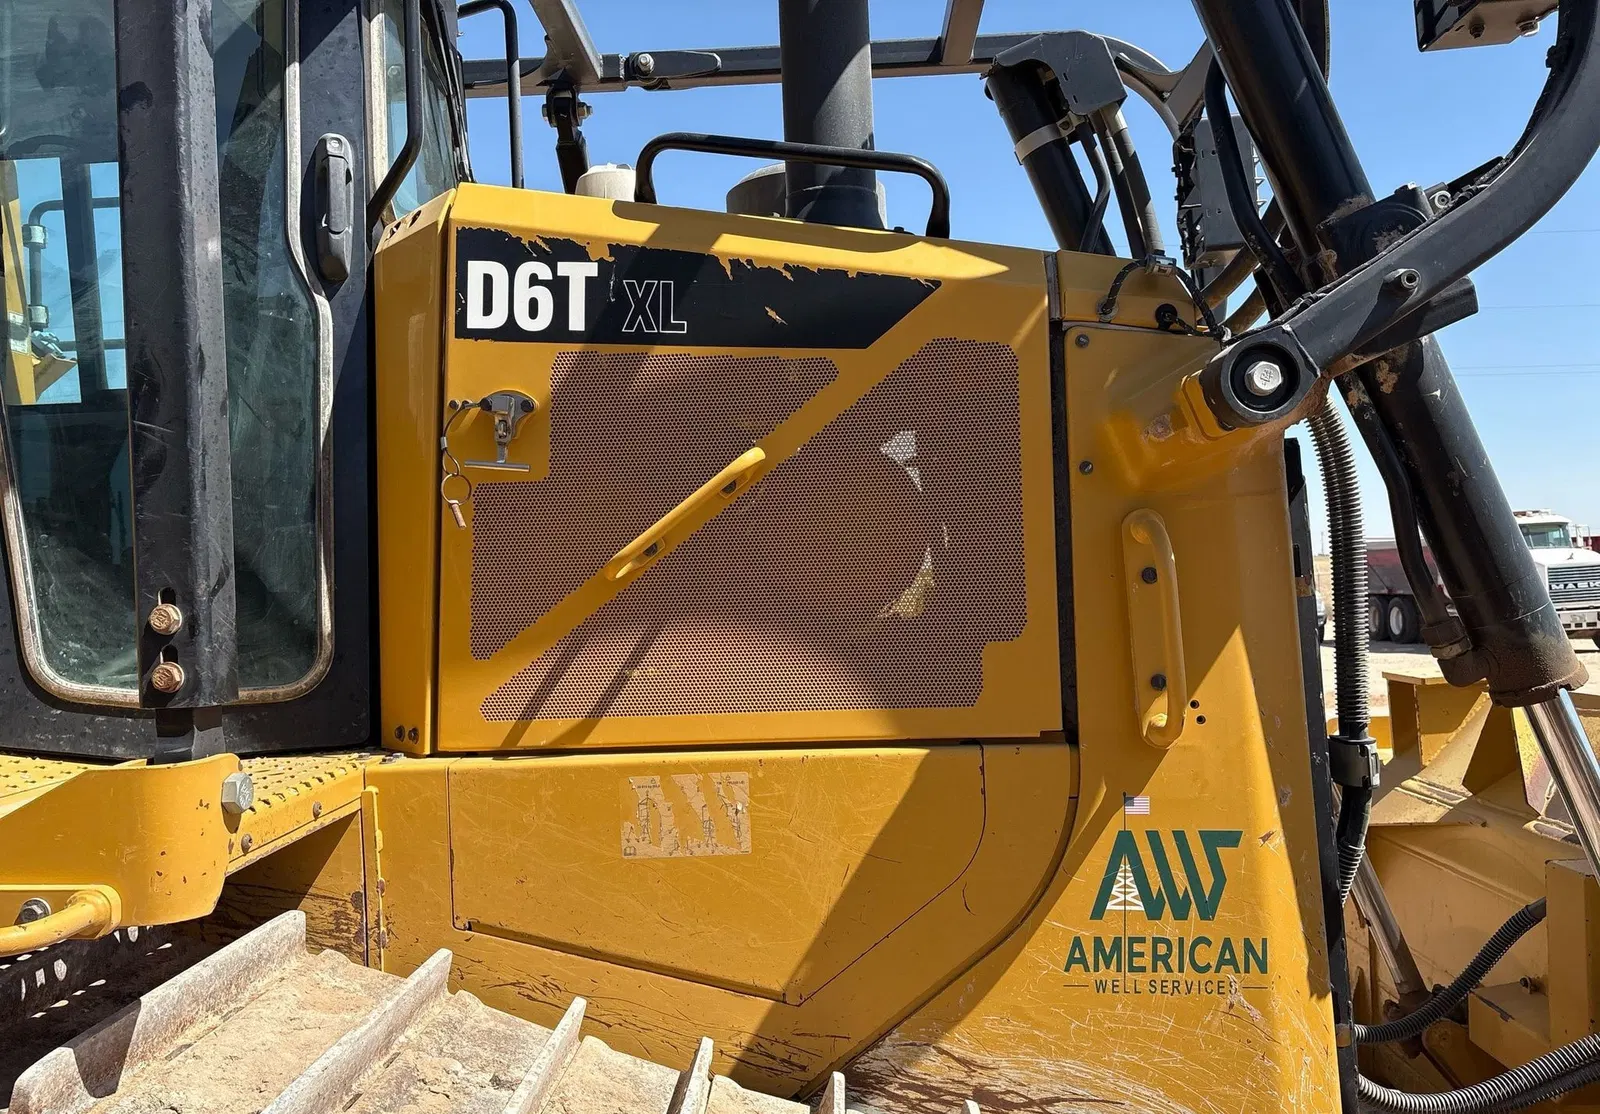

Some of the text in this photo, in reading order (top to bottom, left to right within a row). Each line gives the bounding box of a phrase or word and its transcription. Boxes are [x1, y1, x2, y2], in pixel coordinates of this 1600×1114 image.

[466, 260, 688, 334] D6T XL
[1063, 936, 1268, 974] AMERICAN
[1095, 979, 1142, 994] WELL
